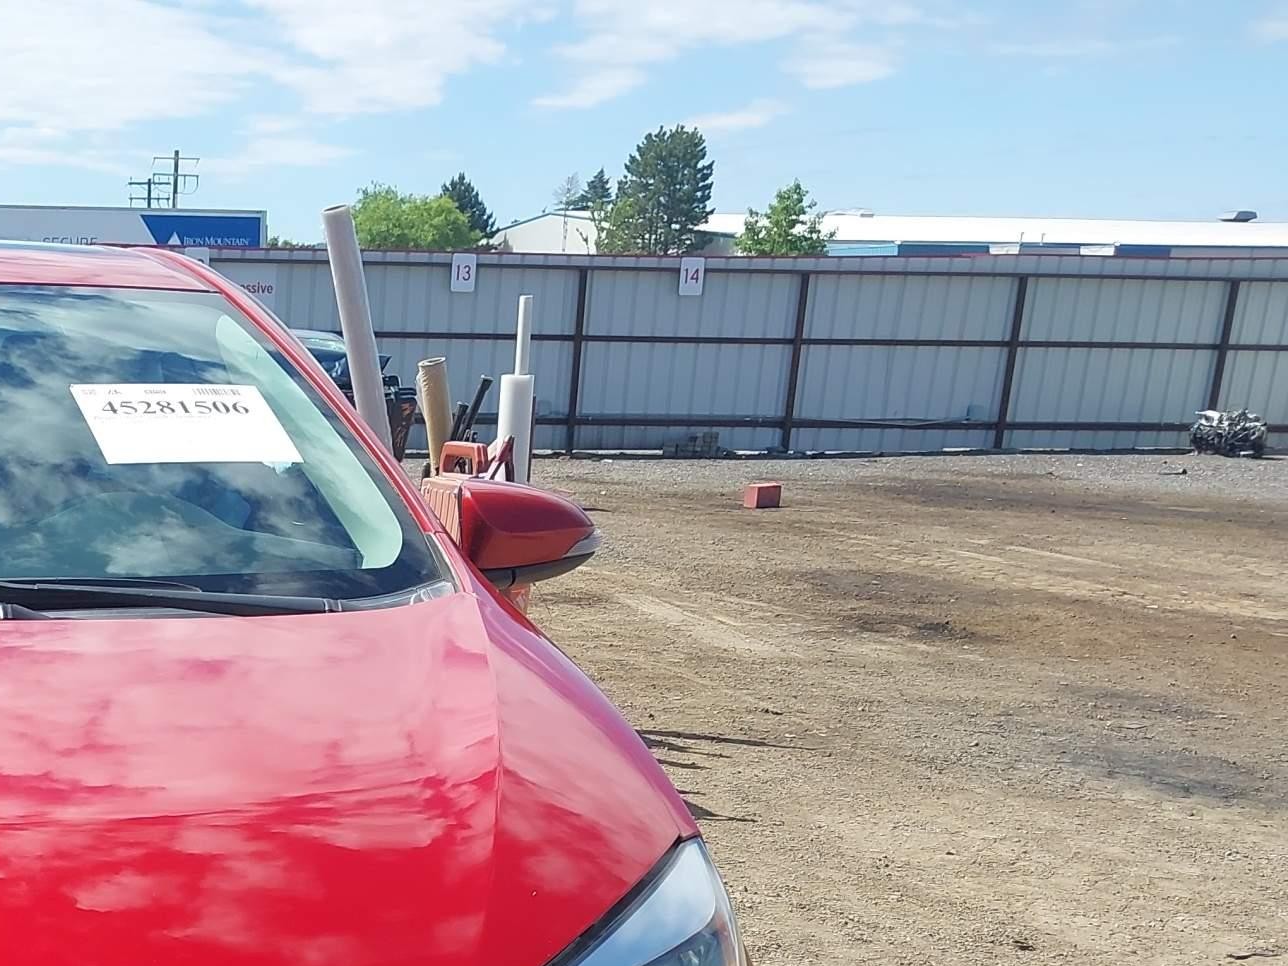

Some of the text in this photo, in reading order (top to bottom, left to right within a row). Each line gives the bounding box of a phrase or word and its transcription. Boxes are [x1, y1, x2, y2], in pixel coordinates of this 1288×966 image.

[183, 235, 249, 246] IRON MOUNTAIN
[456, 264, 472, 281] 13
[683, 267, 700, 284] 14
[102, 400, 250, 415] 45281506
